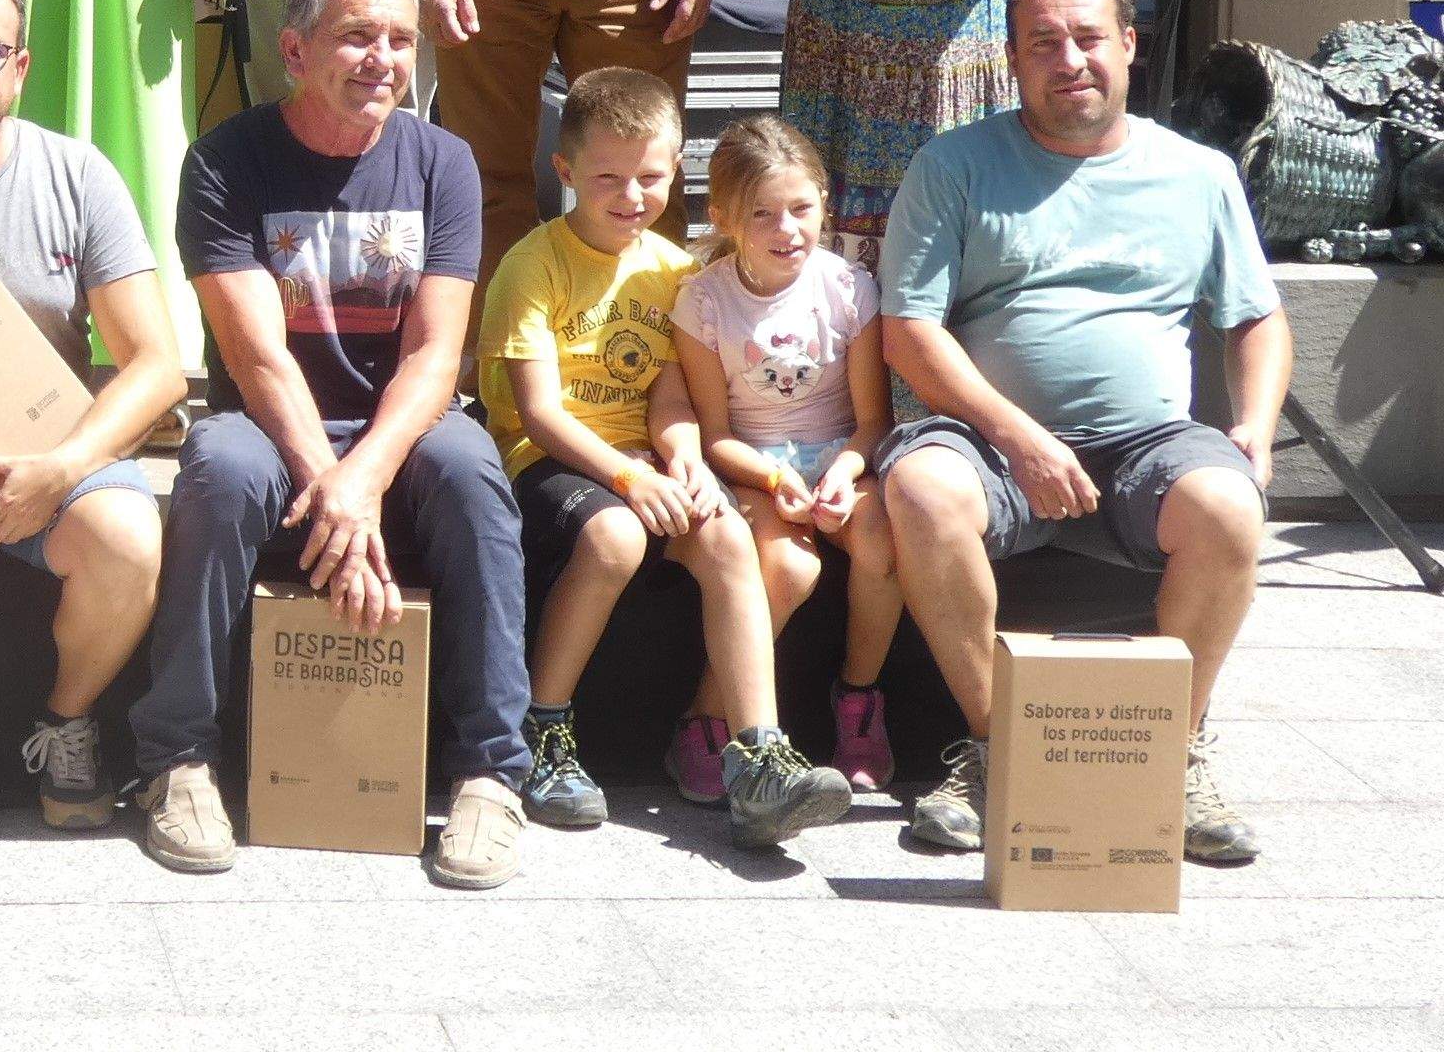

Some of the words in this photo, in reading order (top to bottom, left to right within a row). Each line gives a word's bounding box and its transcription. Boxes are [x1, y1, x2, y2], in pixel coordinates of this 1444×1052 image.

[562, 300, 623, 341] FAIR
[629, 299, 674, 339] BAL
[274, 631, 405, 667] DESPENSA
[274, 661, 294, 679] DE
[300, 661, 405, 688] BARBASTRO
[1024, 703, 1090, 720] Saborea
[1096, 707, 1105, 720] y
[1110, 705, 1173, 721] disfruta
[1043, 726, 1066, 742] los
[1071, 727, 1152, 743] productos
[1044, 747, 1068, 763] del
[1074, 749, 1149, 765] territorio
[1124, 849, 1168, 857] GOBIERNO
